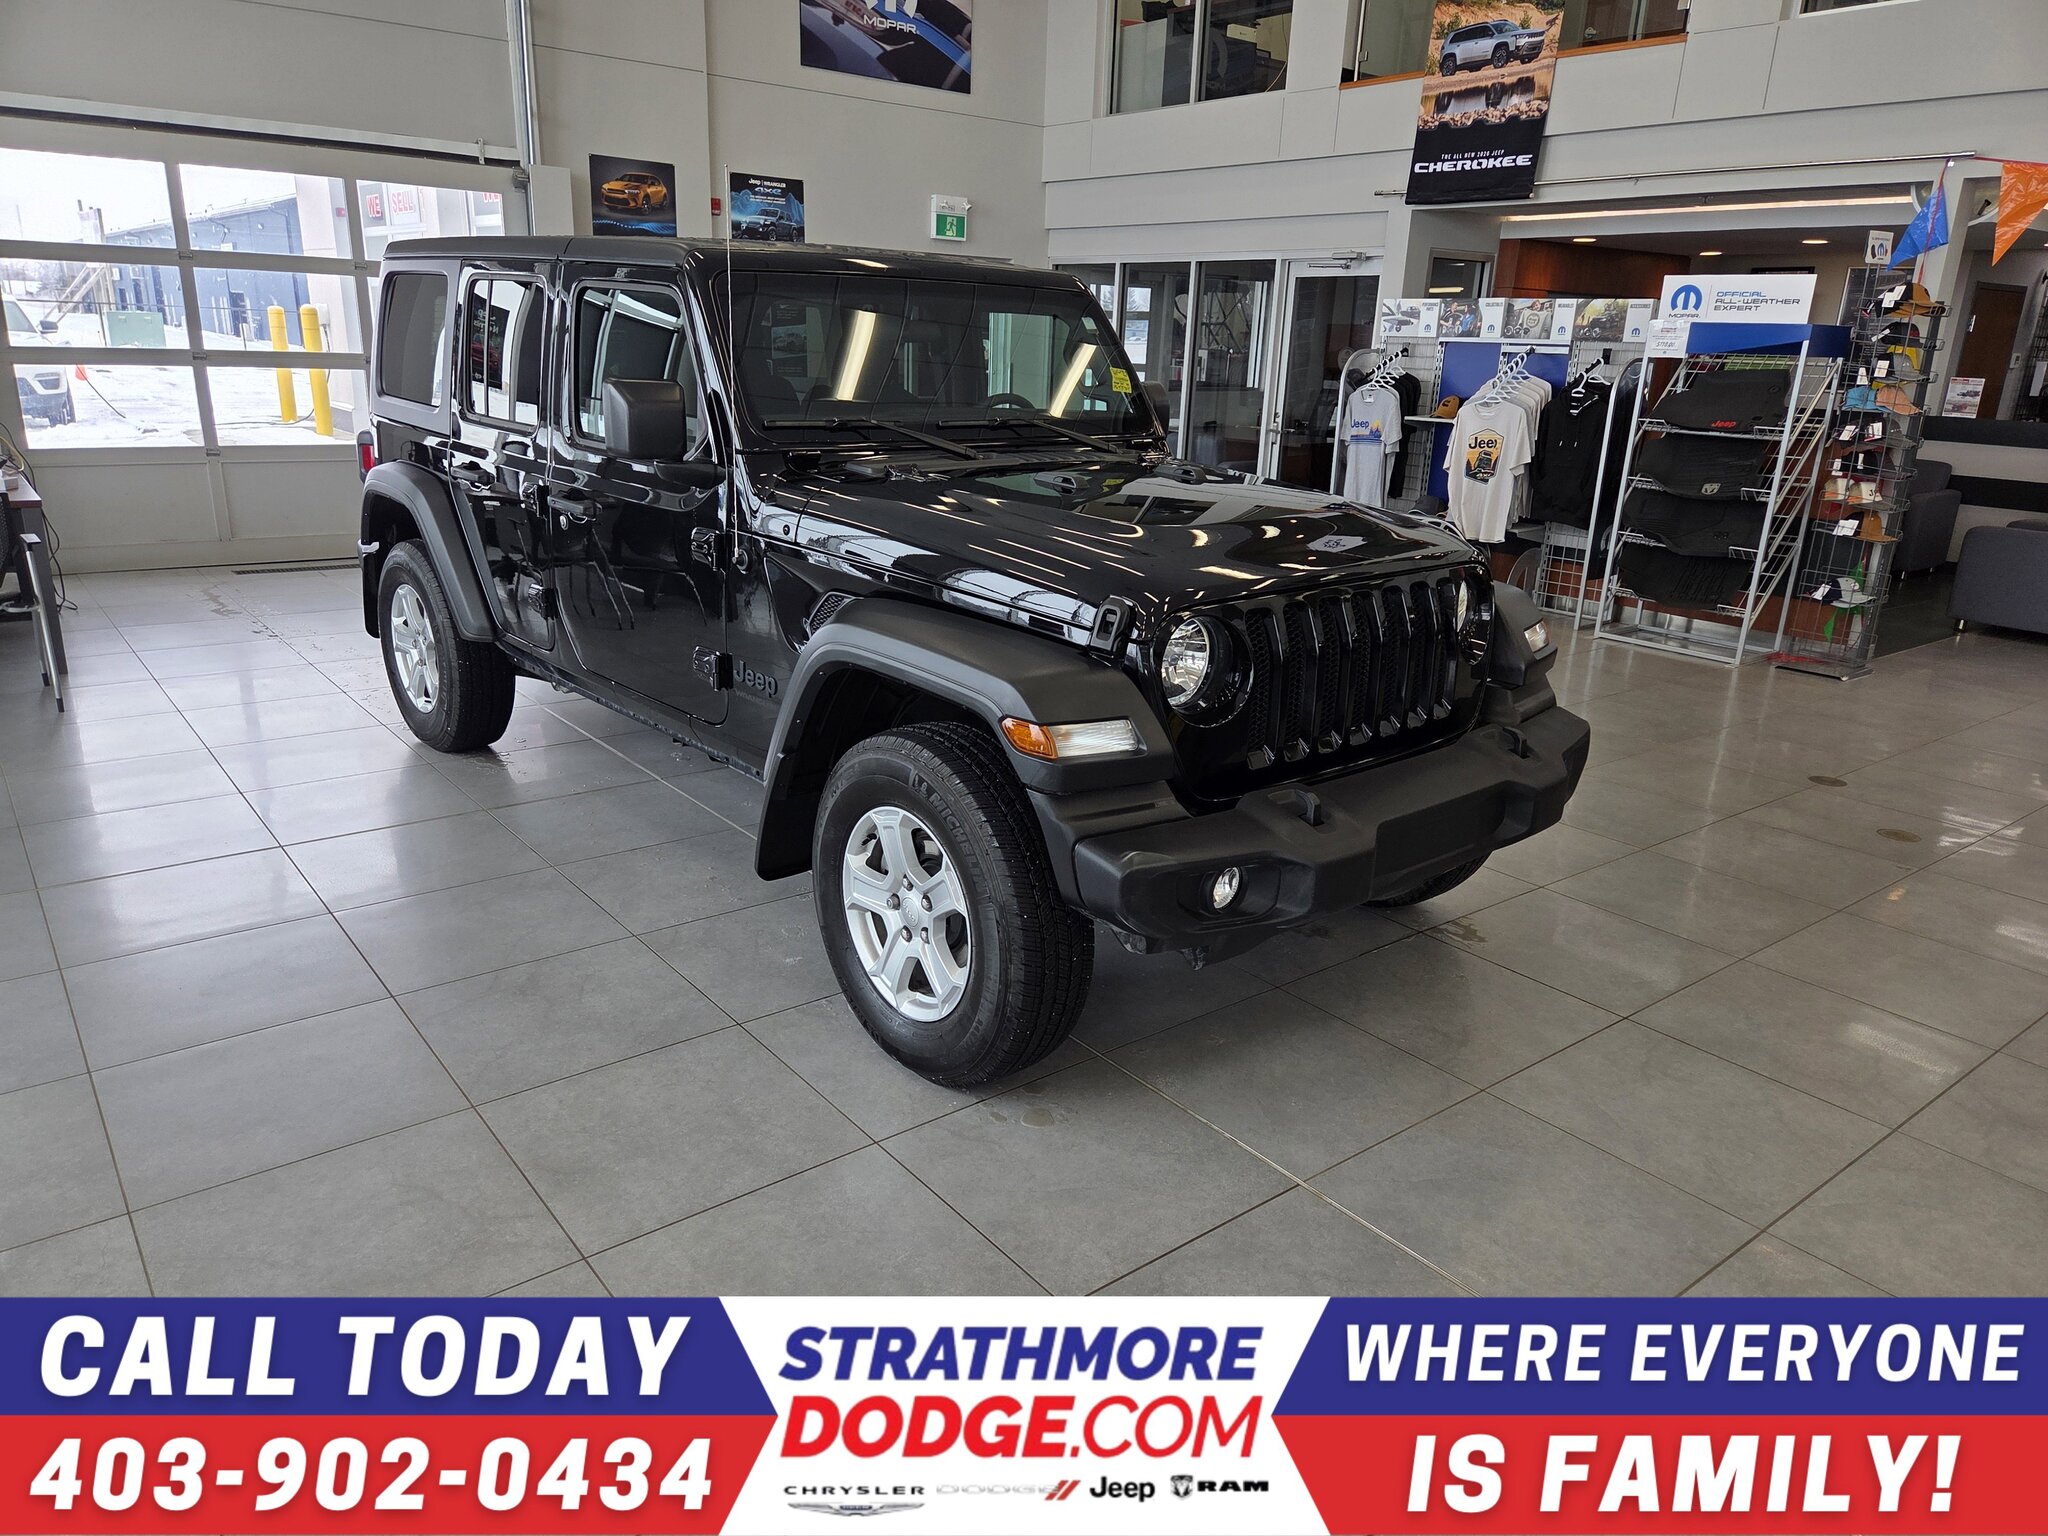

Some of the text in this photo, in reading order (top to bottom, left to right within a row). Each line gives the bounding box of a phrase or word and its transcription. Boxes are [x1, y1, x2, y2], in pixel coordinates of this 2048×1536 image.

[863, 14, 917, 35] MOPAR
[1414, 154, 1533, 173] CHEROKEE
[366, 190, 415, 217] WE SELL
[1351, 419, 1370, 429] Jeep
[1711, 420, 1737, 428] Jeep
[733, 660, 778, 698] Jeep
[929, 792, 989, 896] MICHELIN
